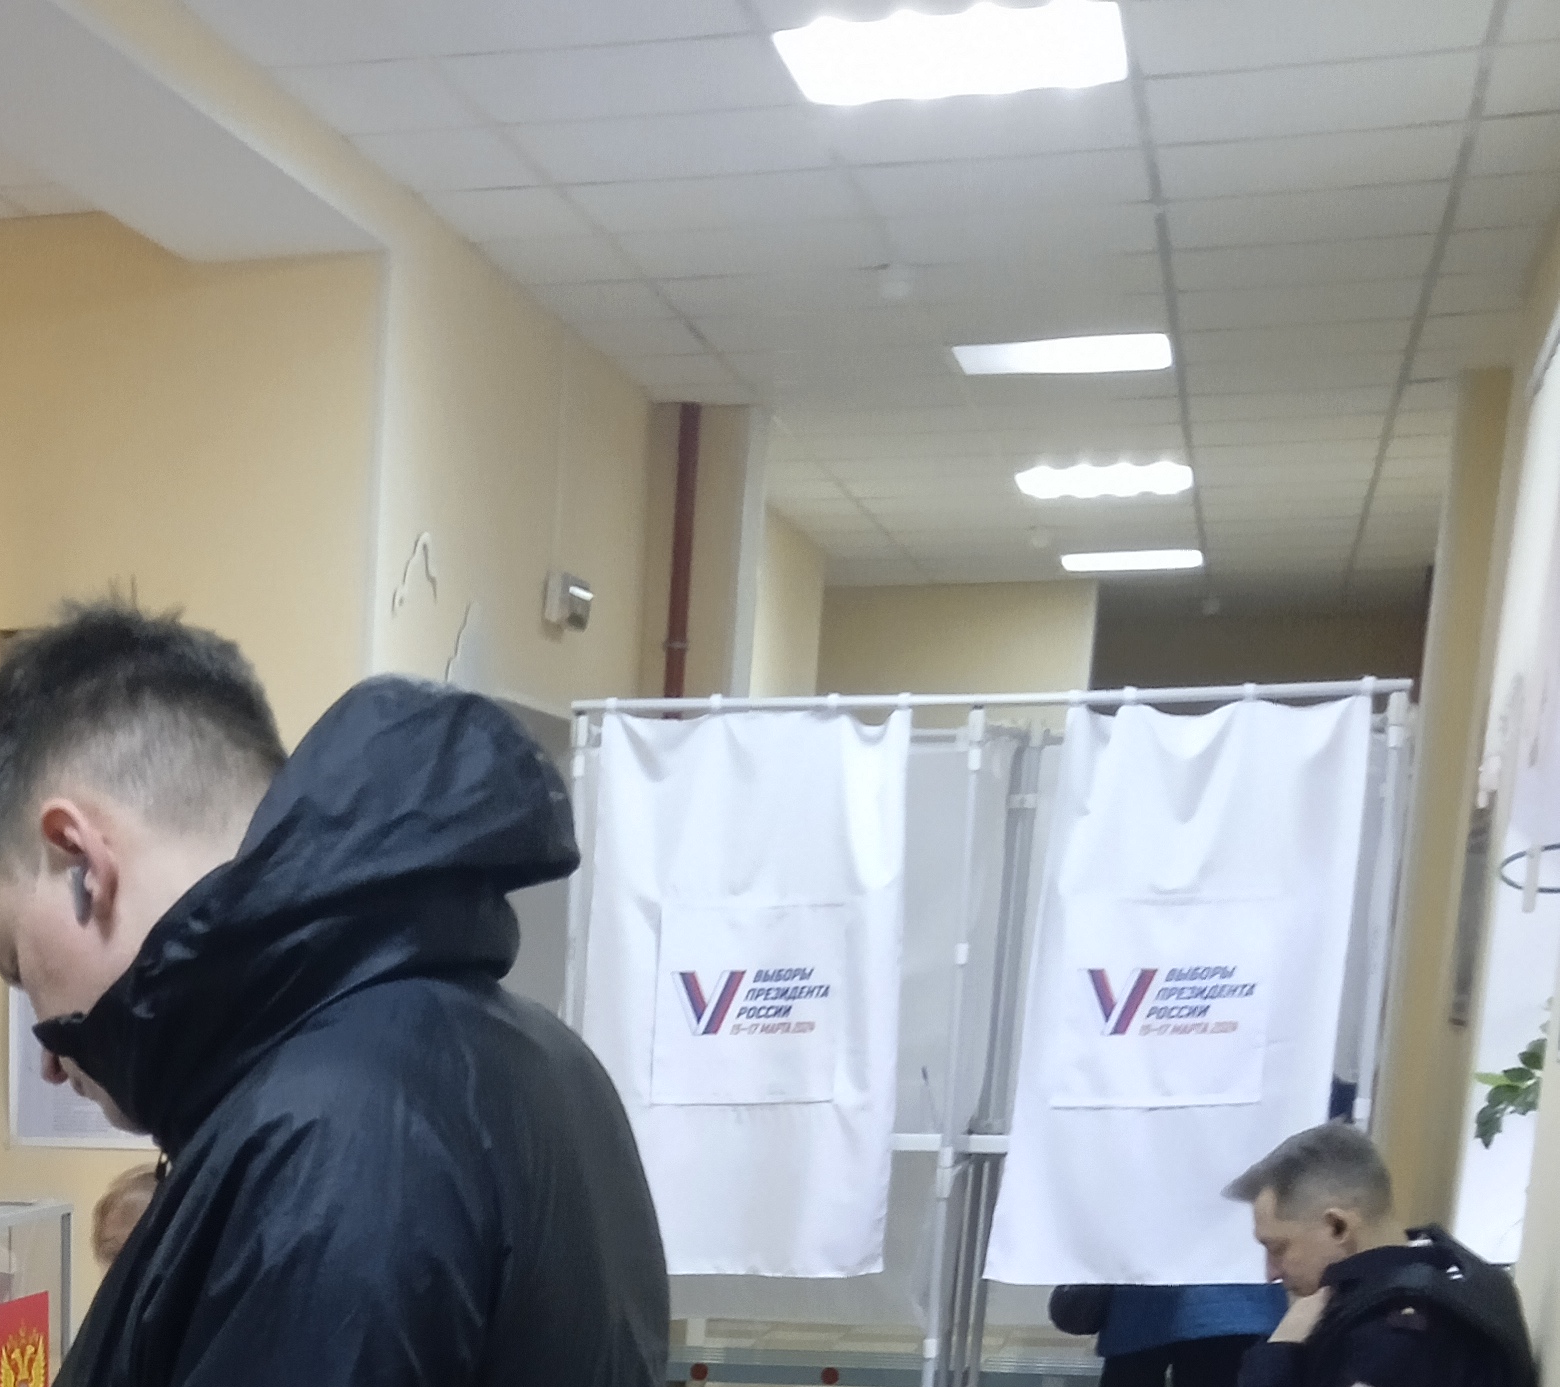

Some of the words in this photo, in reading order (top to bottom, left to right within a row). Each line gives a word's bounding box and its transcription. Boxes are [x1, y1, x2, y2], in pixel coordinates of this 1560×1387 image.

[753, 968, 814, 983] ВЫБОРЫ
[745, 985, 830, 1001] ПРЕЗИДЕНТА
[1155, 983, 1256, 1001] ПРЕЗИДЕНТА
[737, 1005, 792, 1019] РОССИИ
[1146, 1004, 1211, 1019] РОССИИ
